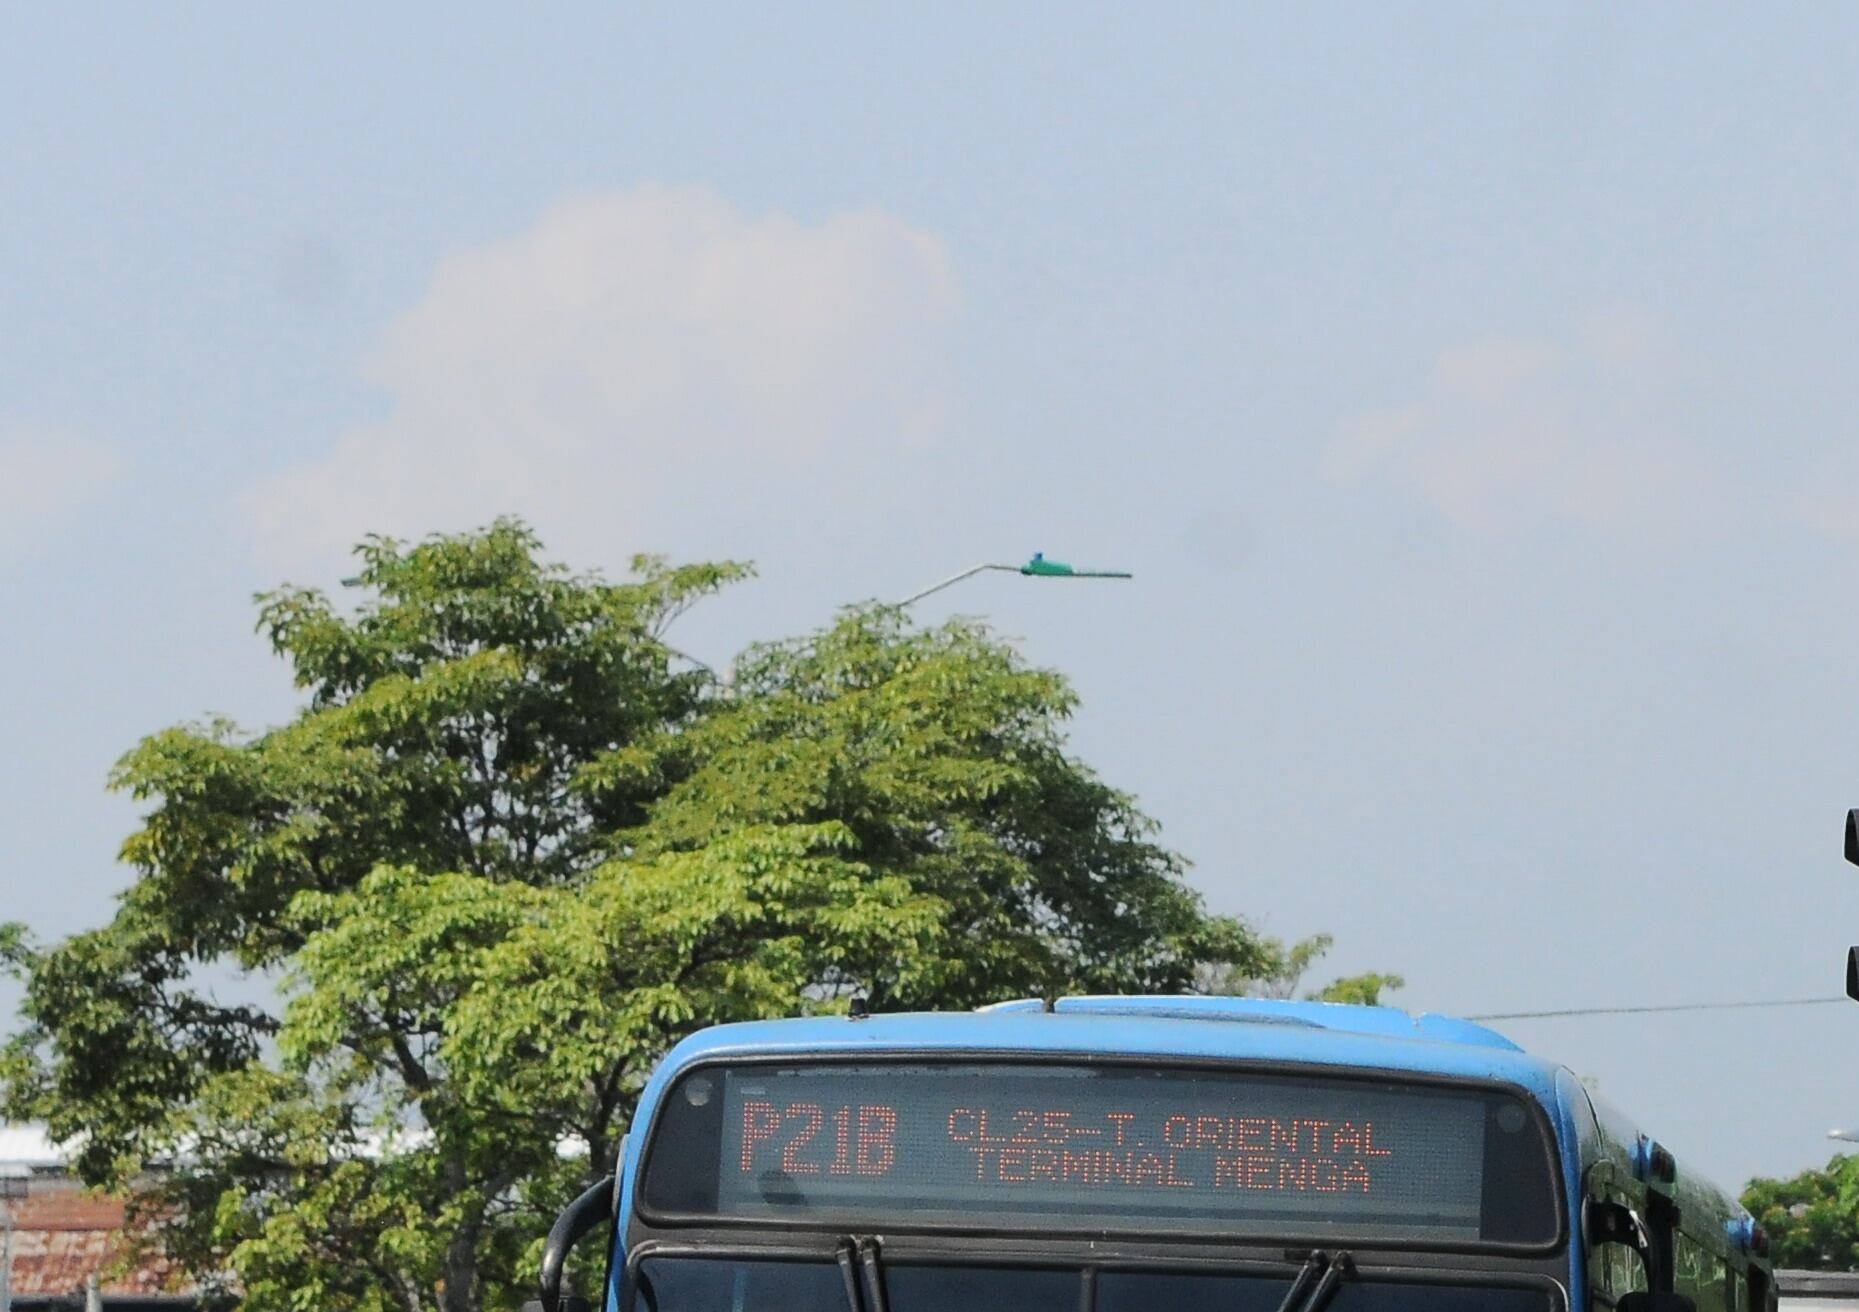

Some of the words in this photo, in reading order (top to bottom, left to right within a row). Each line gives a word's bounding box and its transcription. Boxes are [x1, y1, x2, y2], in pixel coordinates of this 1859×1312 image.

[741, 1101, 897, 1175] P21B
[1164, 1115, 1392, 1155] ORIENTAL
[969, 1148, 1194, 1187] TERMINAL
[1215, 1155, 1371, 1193] MENGA
